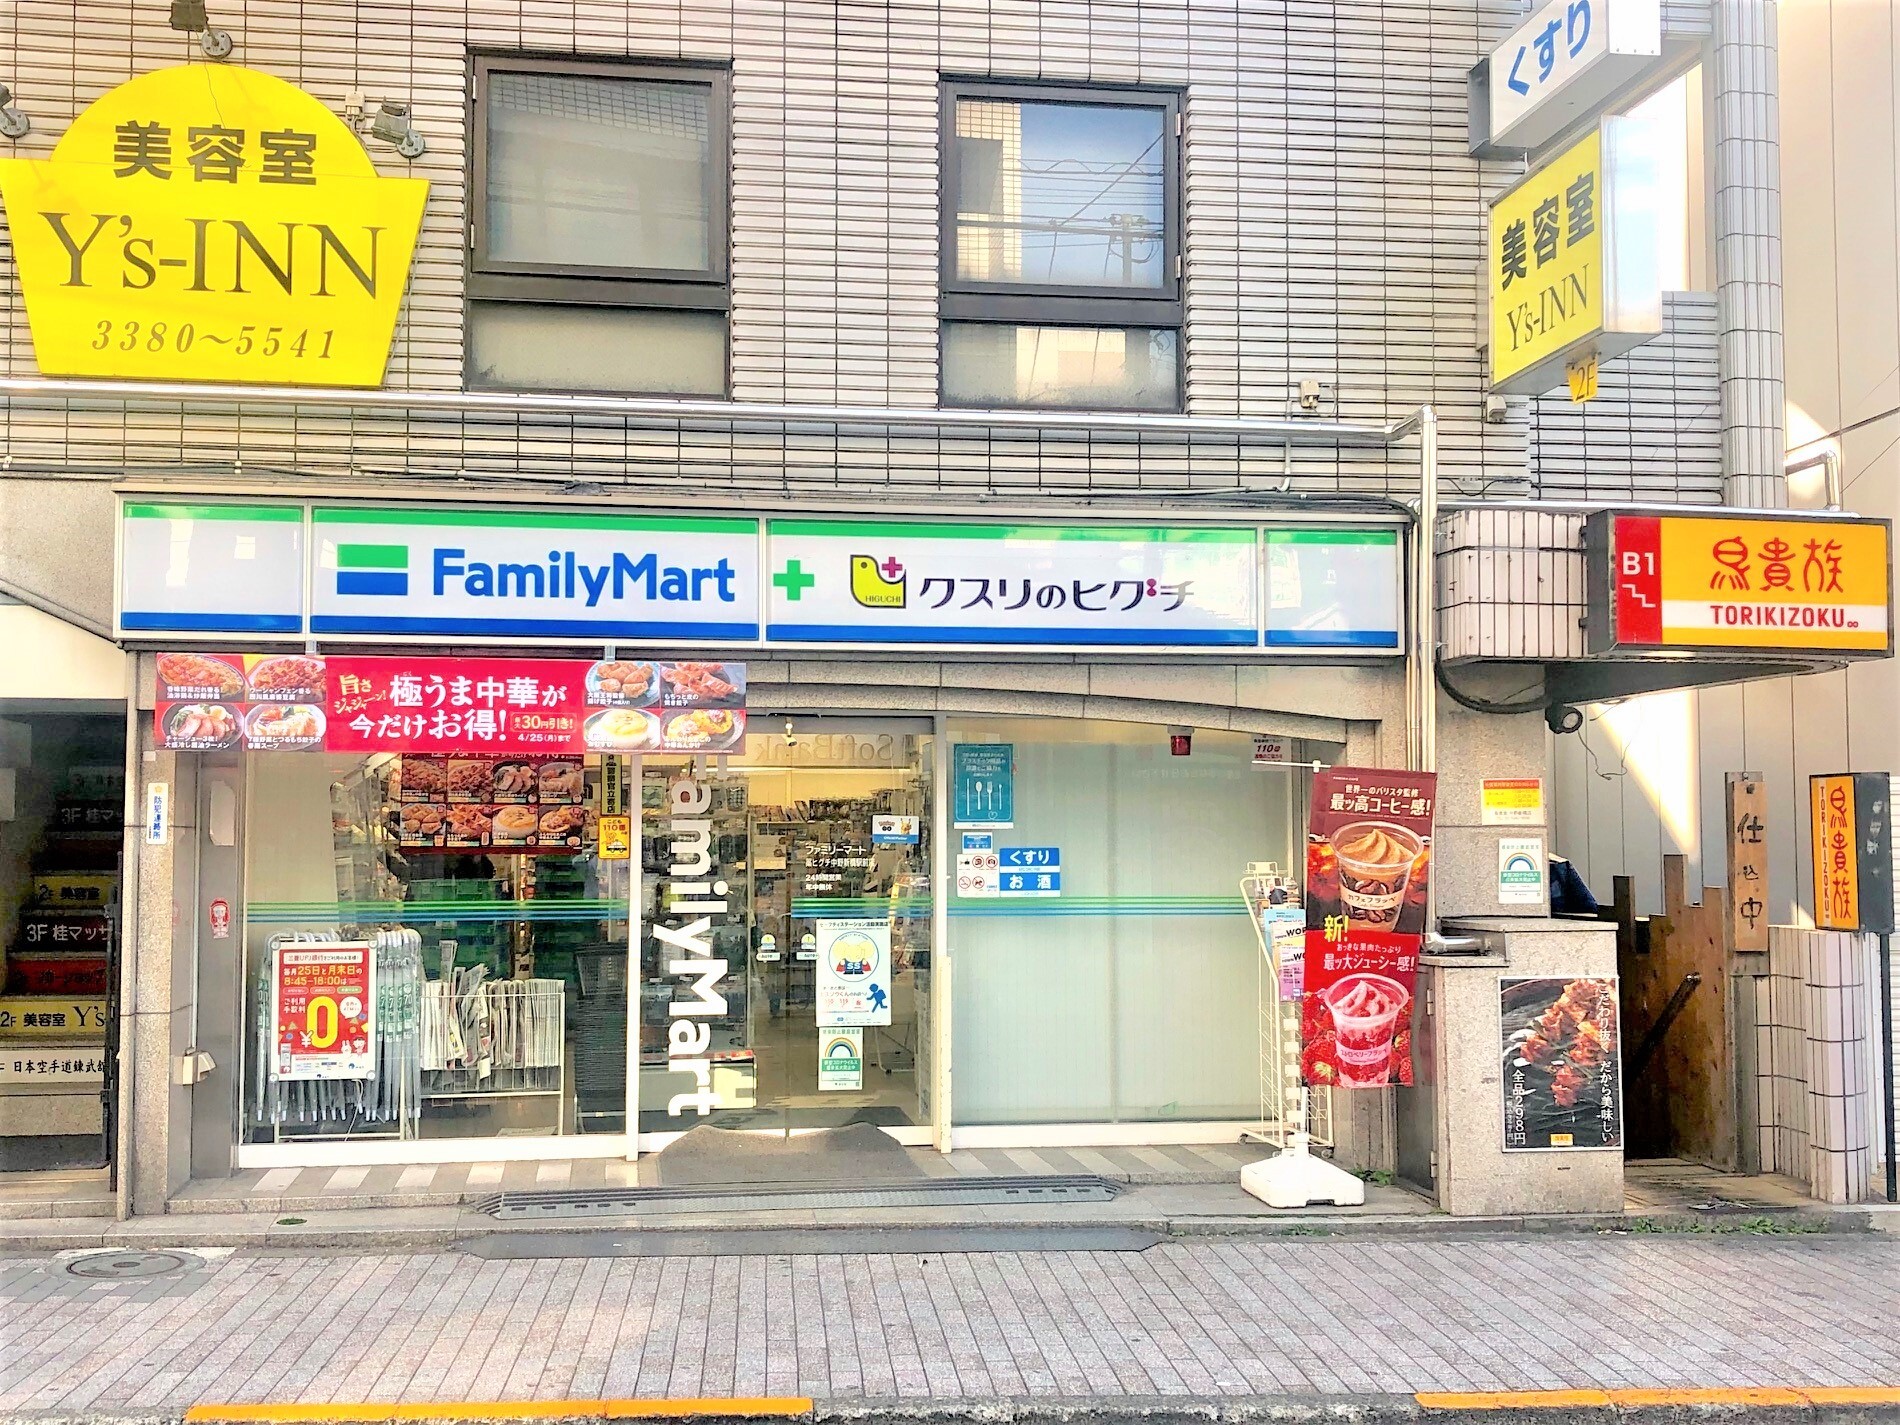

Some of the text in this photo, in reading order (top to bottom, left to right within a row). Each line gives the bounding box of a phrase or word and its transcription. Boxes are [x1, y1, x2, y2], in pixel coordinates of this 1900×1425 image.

[1507, 0, 1591, 96] くすり
[113, 120, 318, 187] 美容室
[1501, 169, 1596, 291] 美容室
[37, 211, 388, 300] Y's-INN
[1506, 264, 1590, 352] Y's-INN
[1576, 367, 1596, 401] 2F
[1622, 551, 1655, 576] B1
[1709, 536, 1844, 594] 鳥貴族
[432, 548, 736, 607] FamilyMart
[865, 595, 901, 603] HIGUCHI
[918, 576, 1196, 613] クスリのヒグチ
[1709, 605, 1846, 628] TORIKIZOKU
[339, 674, 373, 695] 旨さ
[389, 674, 567, 708] 極うま中華が
[349, 708, 507, 742] 今だけお得!
[1345, 784, 1419, 798] 世界一のバリスタ監修
[1329, 793, 1431, 816] 最ッ高コーヒー感!
[805, 845, 867, 856] ファミリーマート
[1009, 850, 1050, 865] くすり
[1009, 875, 1052, 890] お酒
[1736, 813, 1765, 929] 仕込中
[27, 924, 48, 942] 3F
[1324, 914, 1349, 942] 新!
[1337, 943, 1402, 954] おっきな果肉たっぷり
[284, 965, 362, 976] 毎月25日と月末日の
[847, 962, 861, 970] SS
[1323, 952, 1415, 972] 最ッ大ジューシー感!
[284, 997, 306, 1005] ご利用
[284, 1006, 306, 1014] 手数料
[0, 1011, 17, 1027] 2F
[24, 1013, 66, 1027] 美容室
[1511, 1069, 1527, 1146] 全品298円
[1600, 1061, 1614, 1142] だから美味しい
